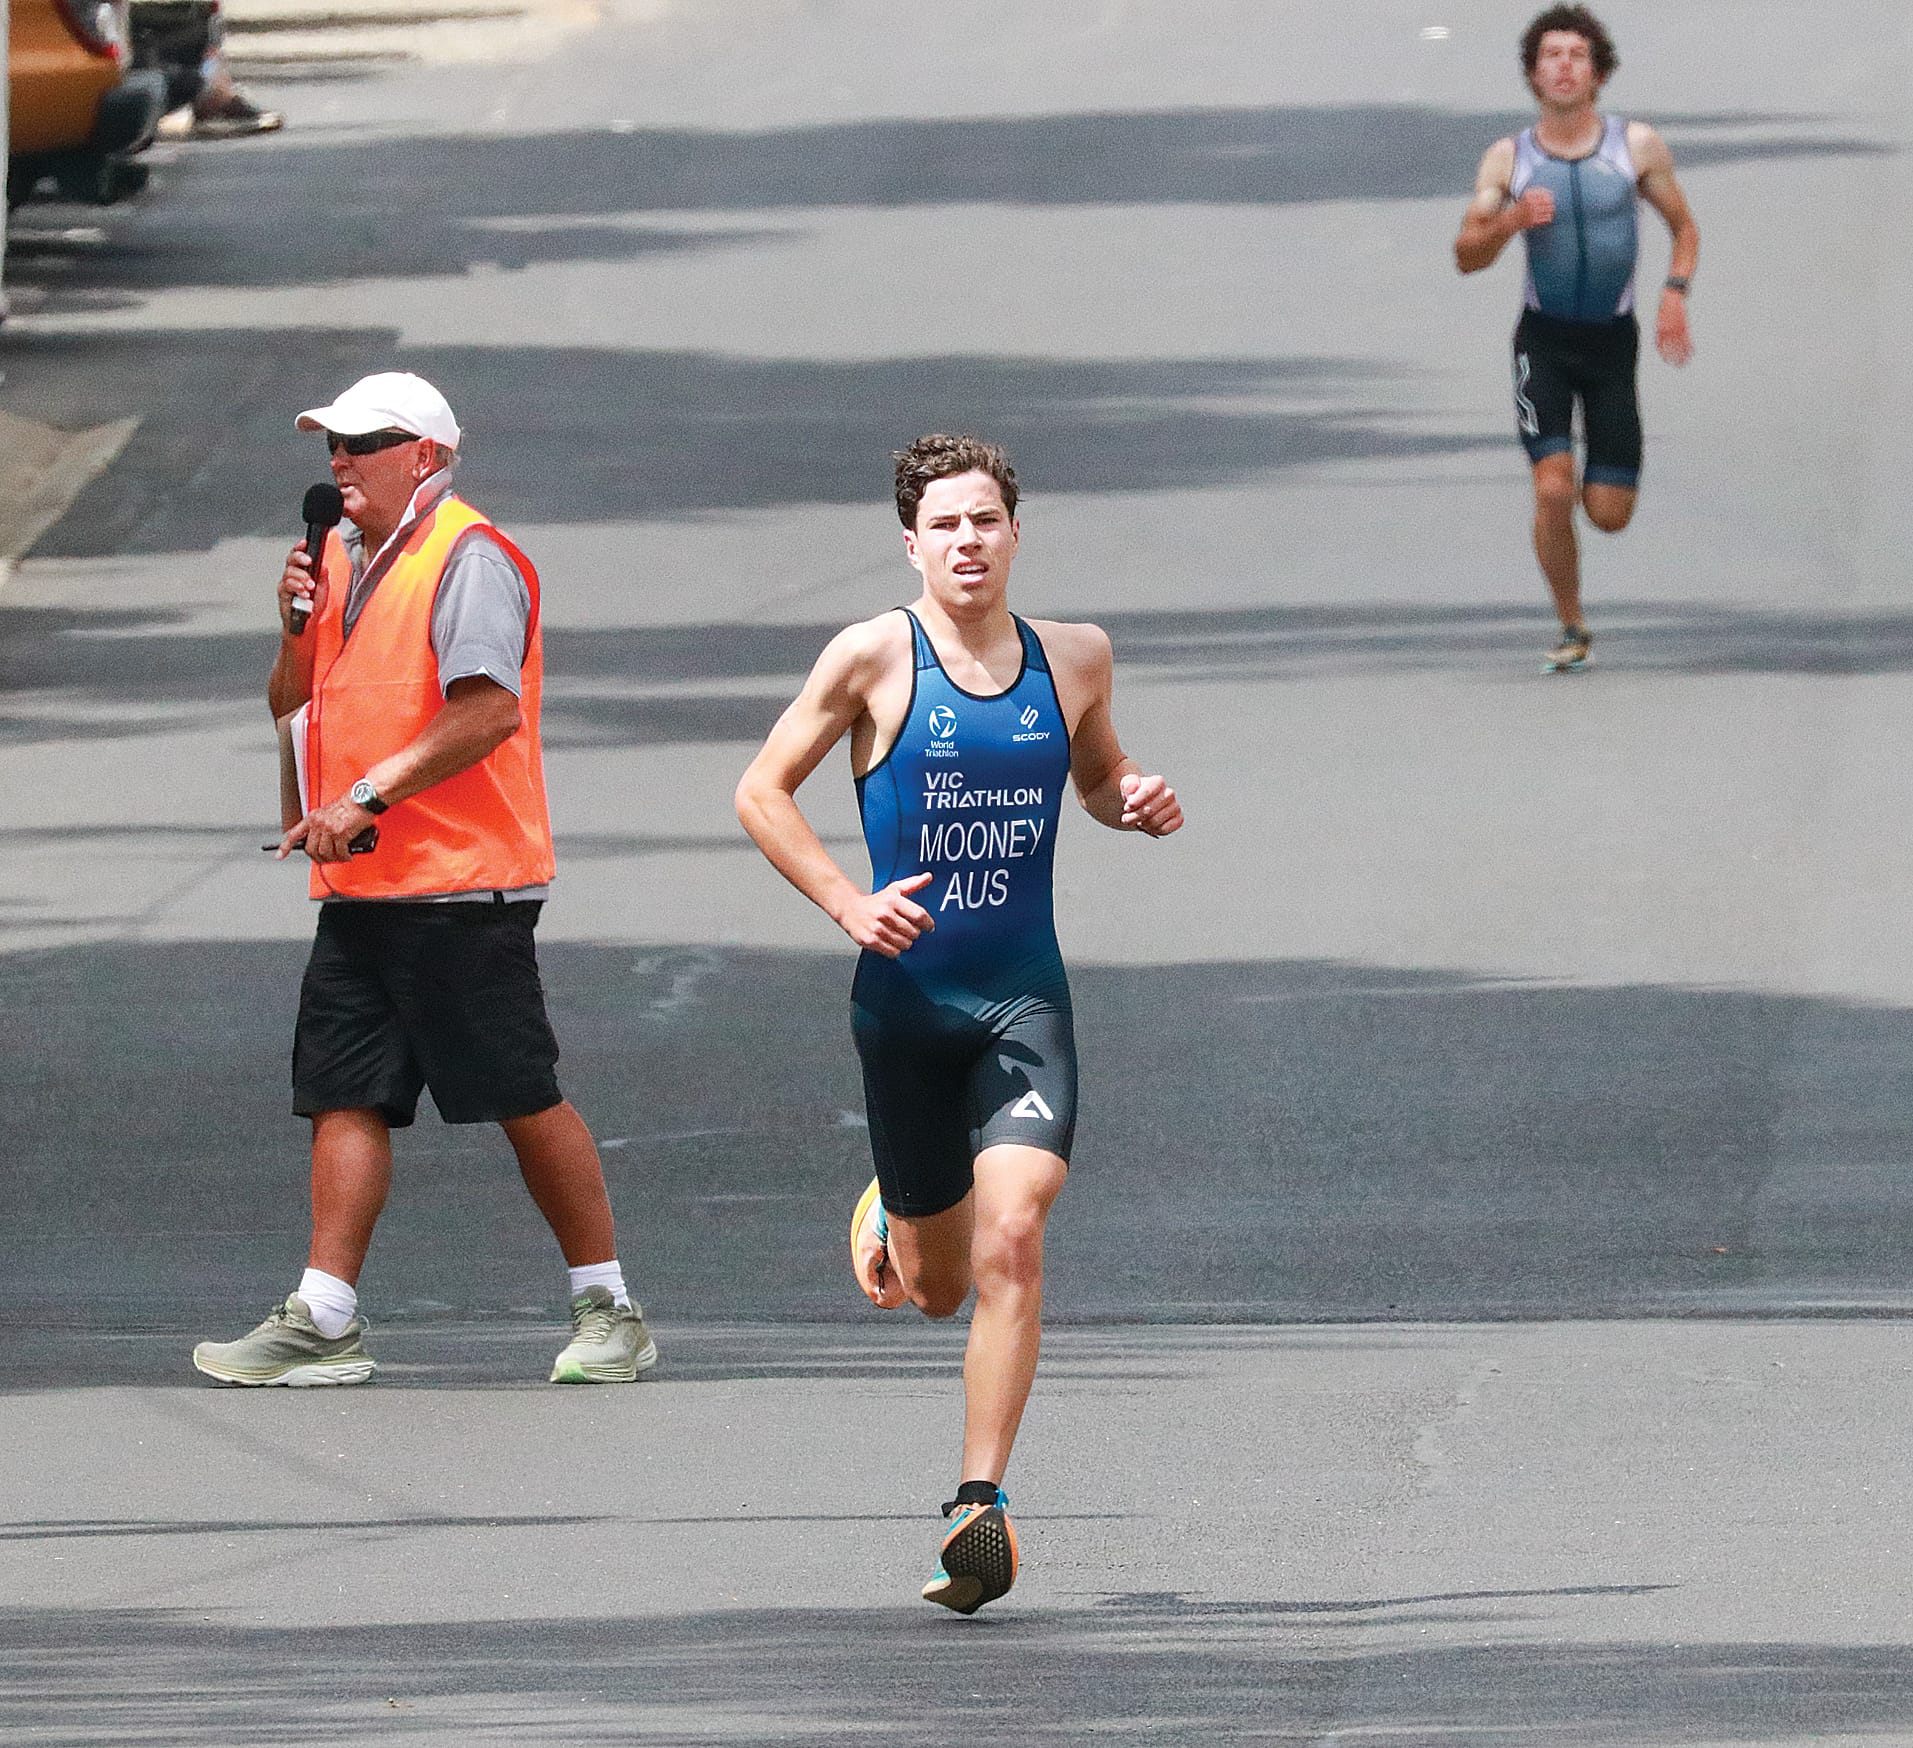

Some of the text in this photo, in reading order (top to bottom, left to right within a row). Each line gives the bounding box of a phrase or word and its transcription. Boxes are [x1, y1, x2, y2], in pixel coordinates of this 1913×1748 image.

[931, 740, 954, 749] World
[1012, 732, 1050, 742] SCODY
[925, 749, 959, 757] Triathlon
[925, 772, 964, 789] VIC
[923, 788, 1042, 810] TRIATHLON
[920, 818, 1044, 862] MOONEY
[940, 869, 1009, 912] AUS
